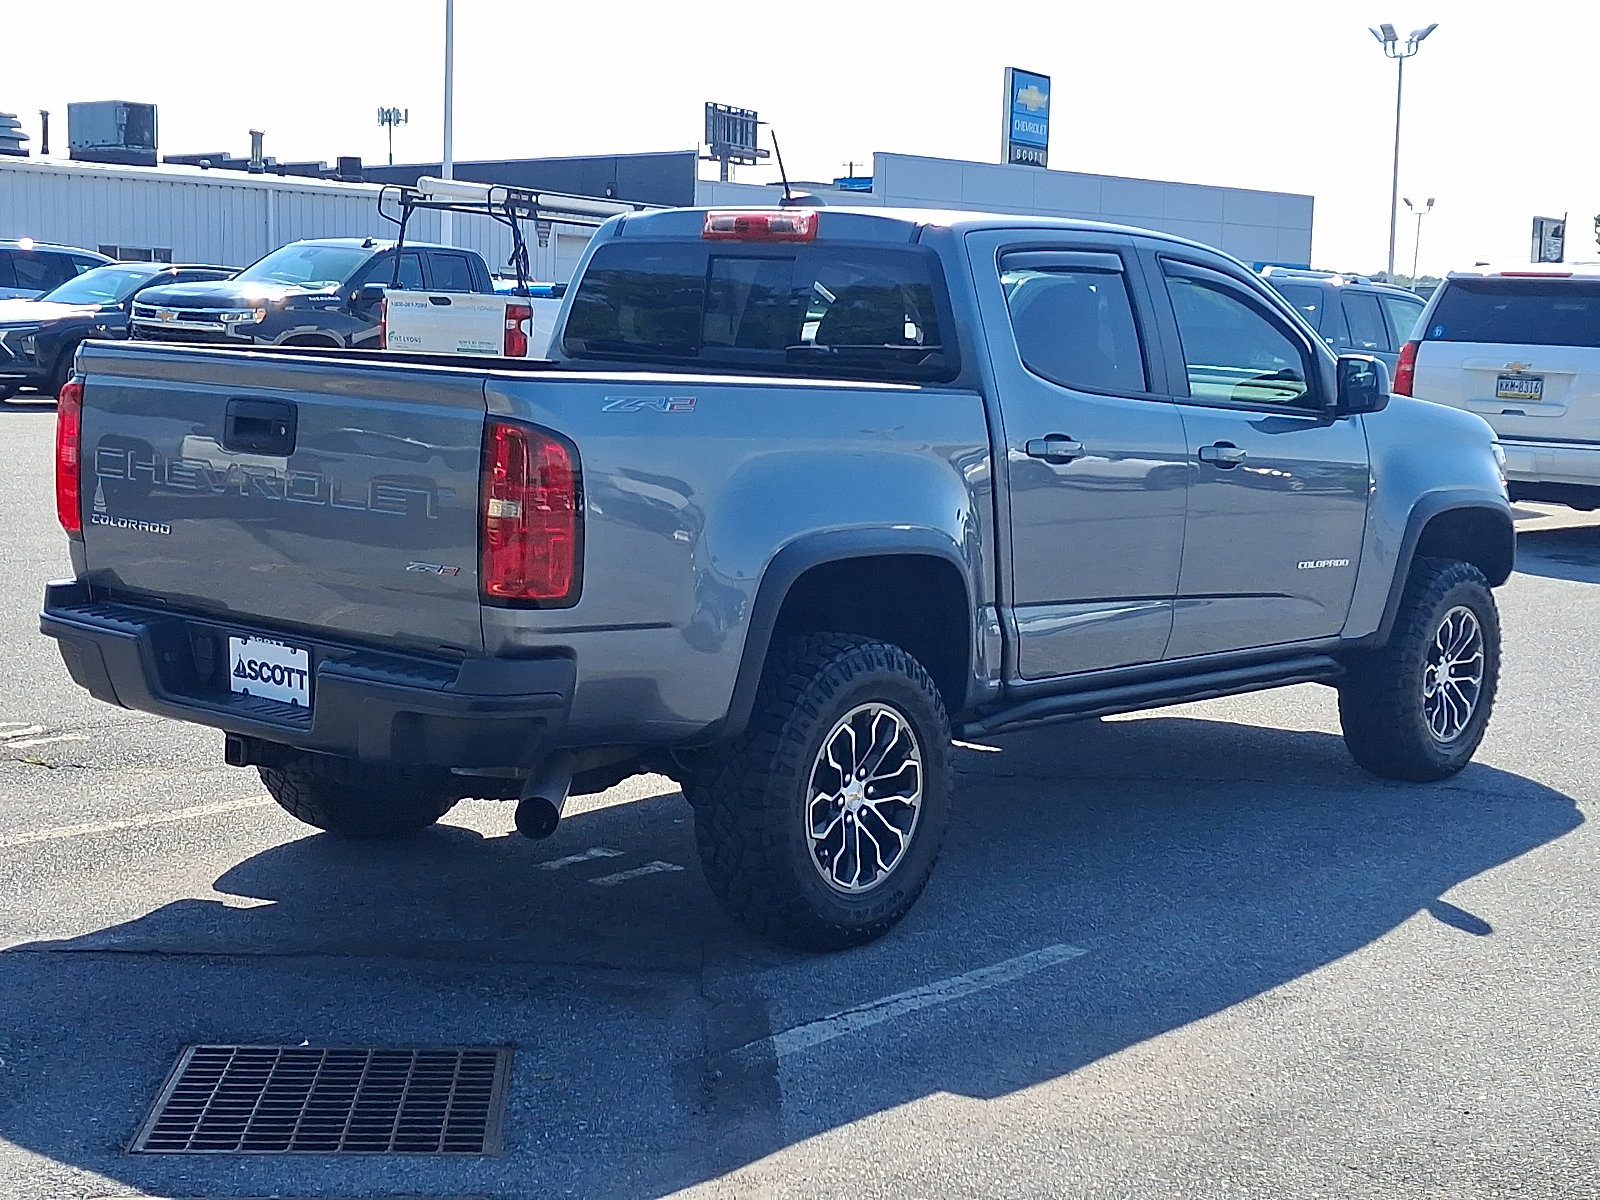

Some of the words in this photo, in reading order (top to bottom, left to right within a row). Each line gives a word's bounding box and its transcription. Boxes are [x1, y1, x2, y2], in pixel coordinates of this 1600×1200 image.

[1014, 119, 1047, 135] CHEVROLET
[1016, 148, 1043, 163] SCOTT
[601, 395, 697, 413] ZR2
[94, 446, 456, 520] CHEVROLET
[91, 513, 172, 535] COLORADO
[1297, 559, 1349, 569] COLORADO
[247, 659, 307, 691] SCOTT
